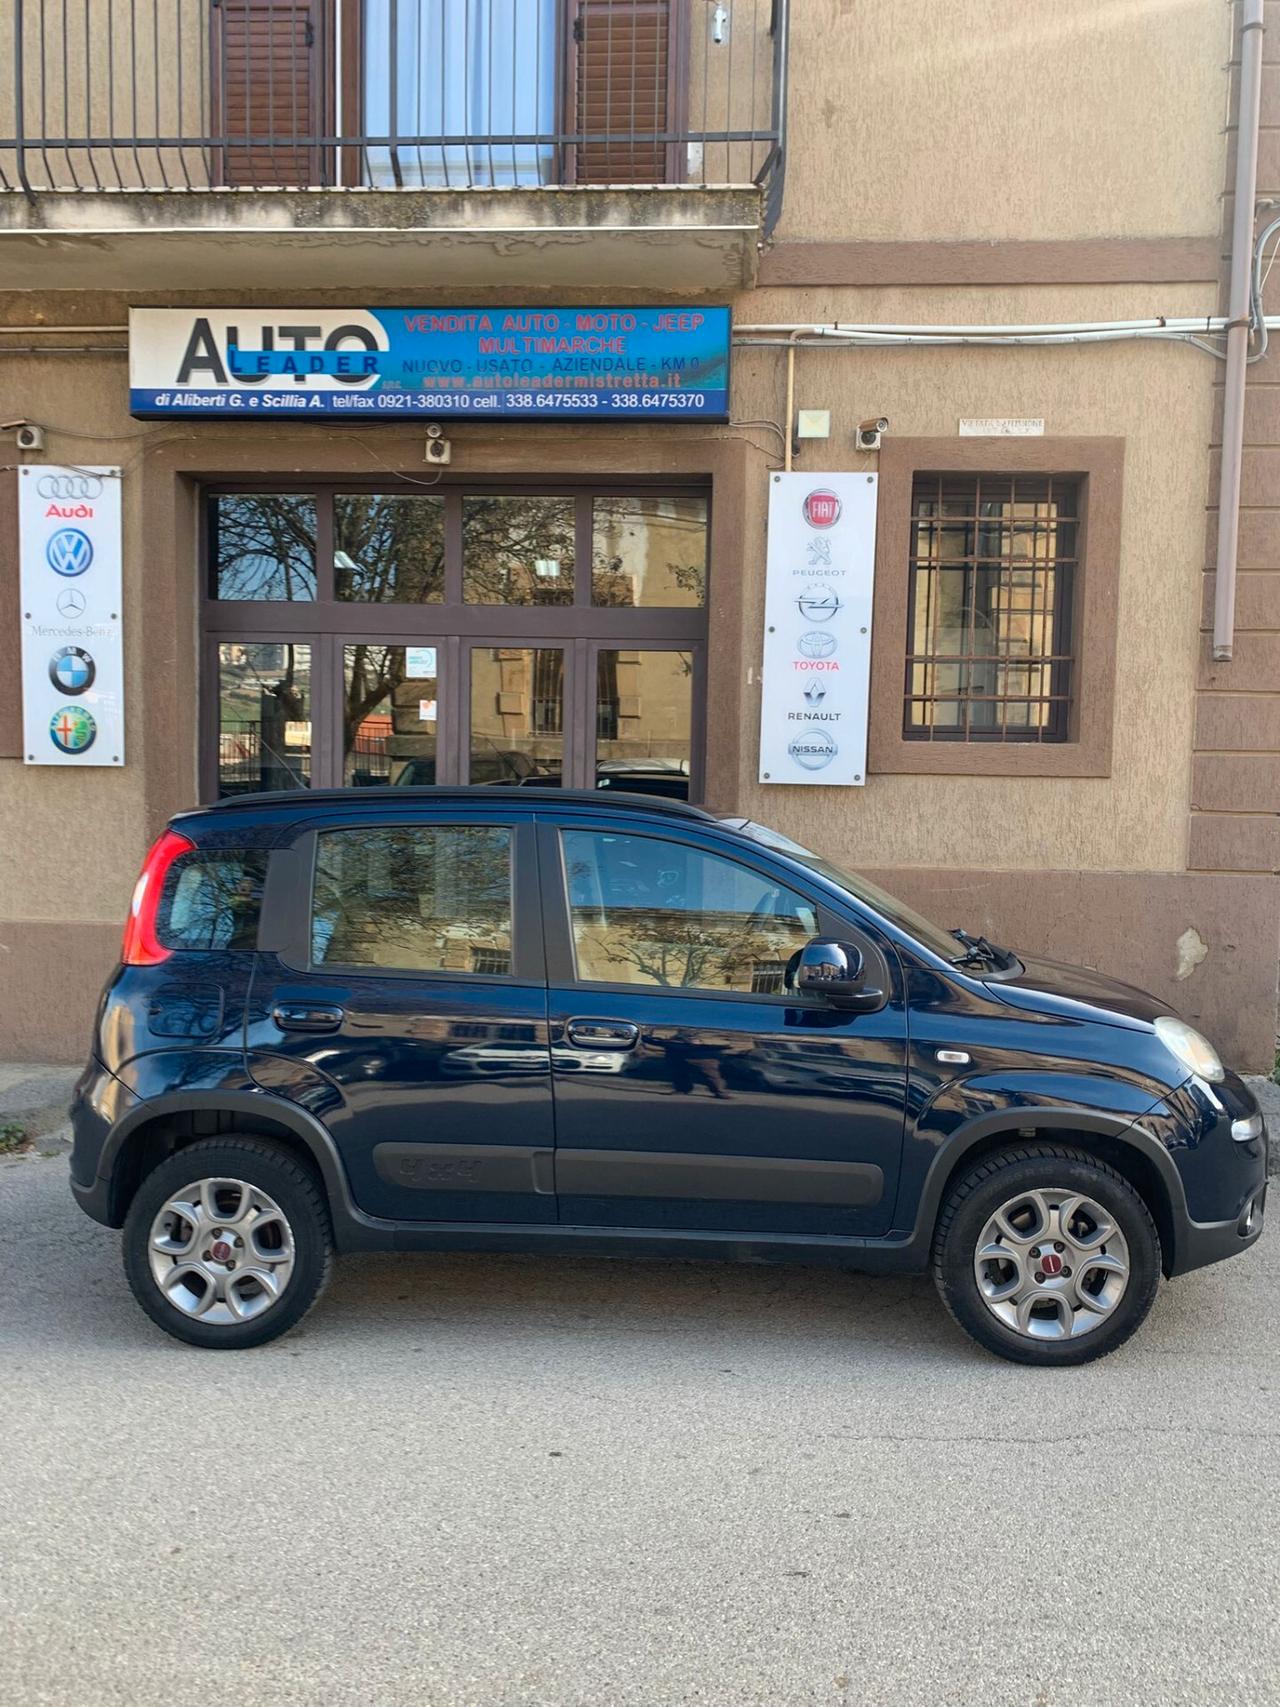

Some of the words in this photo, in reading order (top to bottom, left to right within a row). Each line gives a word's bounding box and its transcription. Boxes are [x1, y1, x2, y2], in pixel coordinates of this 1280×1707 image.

[403, 314, 493, 333] VENDITA
[502, 313, 560, 332] AUTO
[576, 313, 637, 332] MOTO
[652, 313, 704, 332] JEEP
[176, 317, 379, 384] AUTO
[479, 336, 626, 354] MULTIMARCHE
[230, 352, 379, 373] LEADER
[402, 359, 462, 373] NUOVO
[476, 358, 533, 373] USATO
[552, 357, 646, 371] AZIENDALE
[661, 357, 685, 370] KM
[423, 373, 681, 389] www.autoleadermistretta.it
[155, 393, 170, 406] di
[172, 393, 226, 406] Aliberti
[229, 394, 245, 407] G.
[249, 396, 259, 407] e
[262, 394, 306, 407] Scillia
[309, 394, 325, 407] A.
[332, 394, 374, 408] tel/fax
[377, 394, 469, 408] 0921-380310
[473, 394, 501, 408] cell.
[506, 394, 598, 408] 338.6475533
[611, 394, 705, 408] 338.6475370
[46, 504, 93, 518] Audi
[812, 501, 834, 518] FIAT
[792, 569, 847, 577] PEUGEOT
[793, 661, 840, 671] TOYOTA
[787, 712, 841, 721] RENAULT
[792, 745, 833, 753] NISSAN
